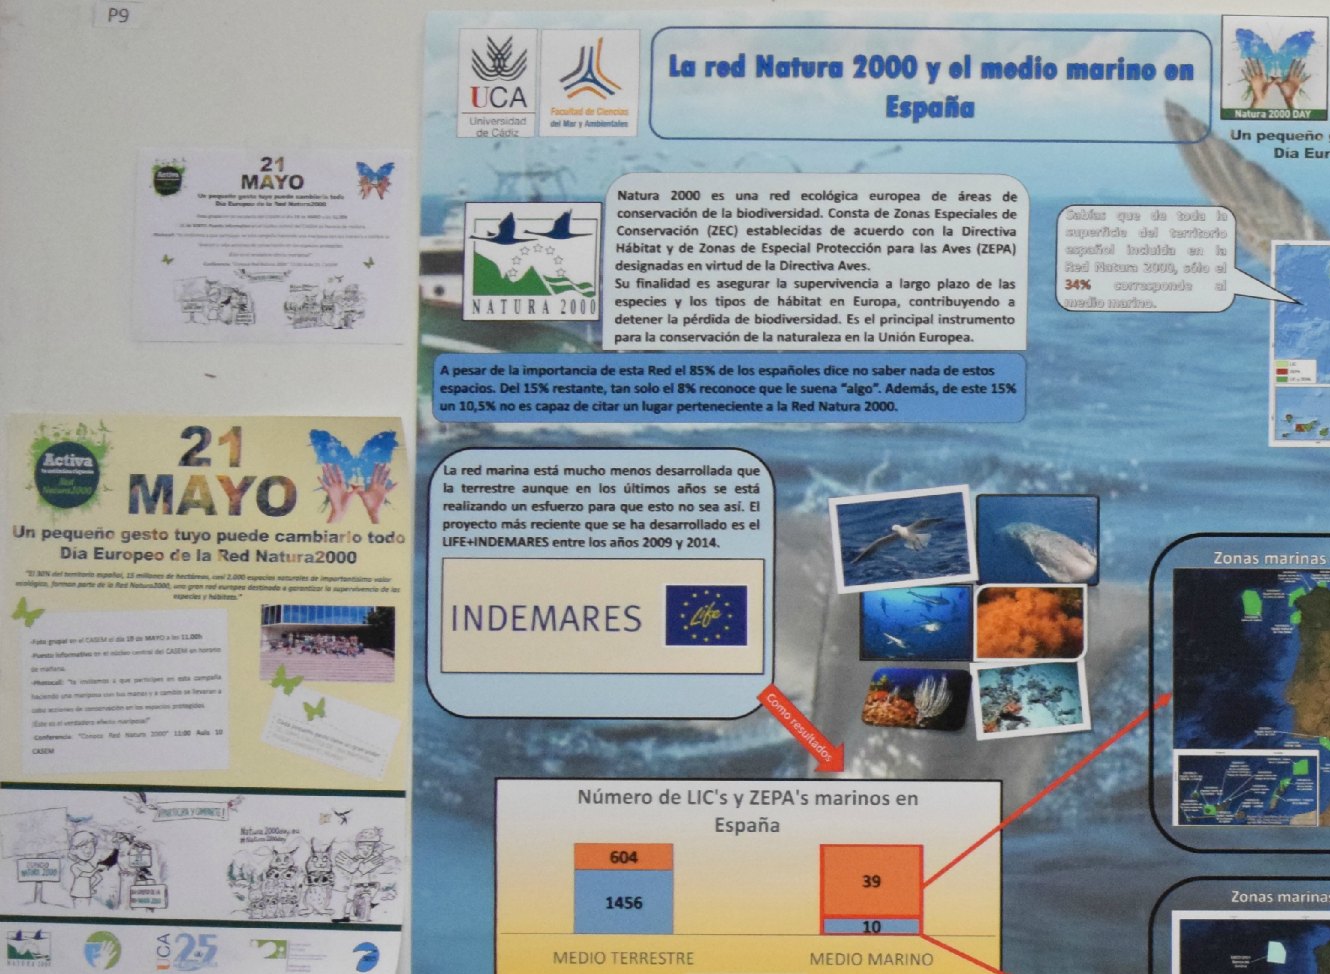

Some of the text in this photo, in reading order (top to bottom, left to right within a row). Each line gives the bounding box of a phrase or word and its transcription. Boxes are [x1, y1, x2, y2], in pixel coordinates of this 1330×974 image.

[108, 8, 129, 23] P9
[669, 53, 1194, 85] La red Natura 2000 y el medio marino en
[471, 86, 527, 108] UCA
[886, 95, 975, 124] España
[1236, 110, 1311, 118] Natura 2000 DAY
[470, 117, 527, 126] Universidad
[260, 157, 284, 172] 21
[242, 175, 304, 190] MAYO
[617, 190, 1018, 203] Natura 2000 es una red ecológica europea de áreas de
[615, 260, 870, 273] designadas en virtud de la Directiva Aves.
[1065, 279, 1091, 290] 34%
[473, 299, 596, 315] NATURA 2000
[179, 426, 241, 467] 21
[128, 474, 297, 517] MAYO
[443, 537, 720, 550] LIFE+INDEMARES entre los años 2009 y 2014.
[1214, 552, 1259, 565] Zonas
[1264, 552, 1326, 565] marinas
[453, 605, 642, 632] INDEMARES
[766, 693, 833, 763] Como resultados
[579, 788, 918, 809] Número de LIC's y ZEPA's marinos en
[716, 817, 780, 836] España
[610, 851, 639, 864] 604
[863, 875, 881, 888] 39
[606, 896, 643, 910] 1456
[1232, 891, 1273, 903] Zonas
[863, 921, 881, 934] 10
[554, 952, 694, 965] MEDIO TERRESTRE
[810, 953, 934, 966] MEDIO MARINO
